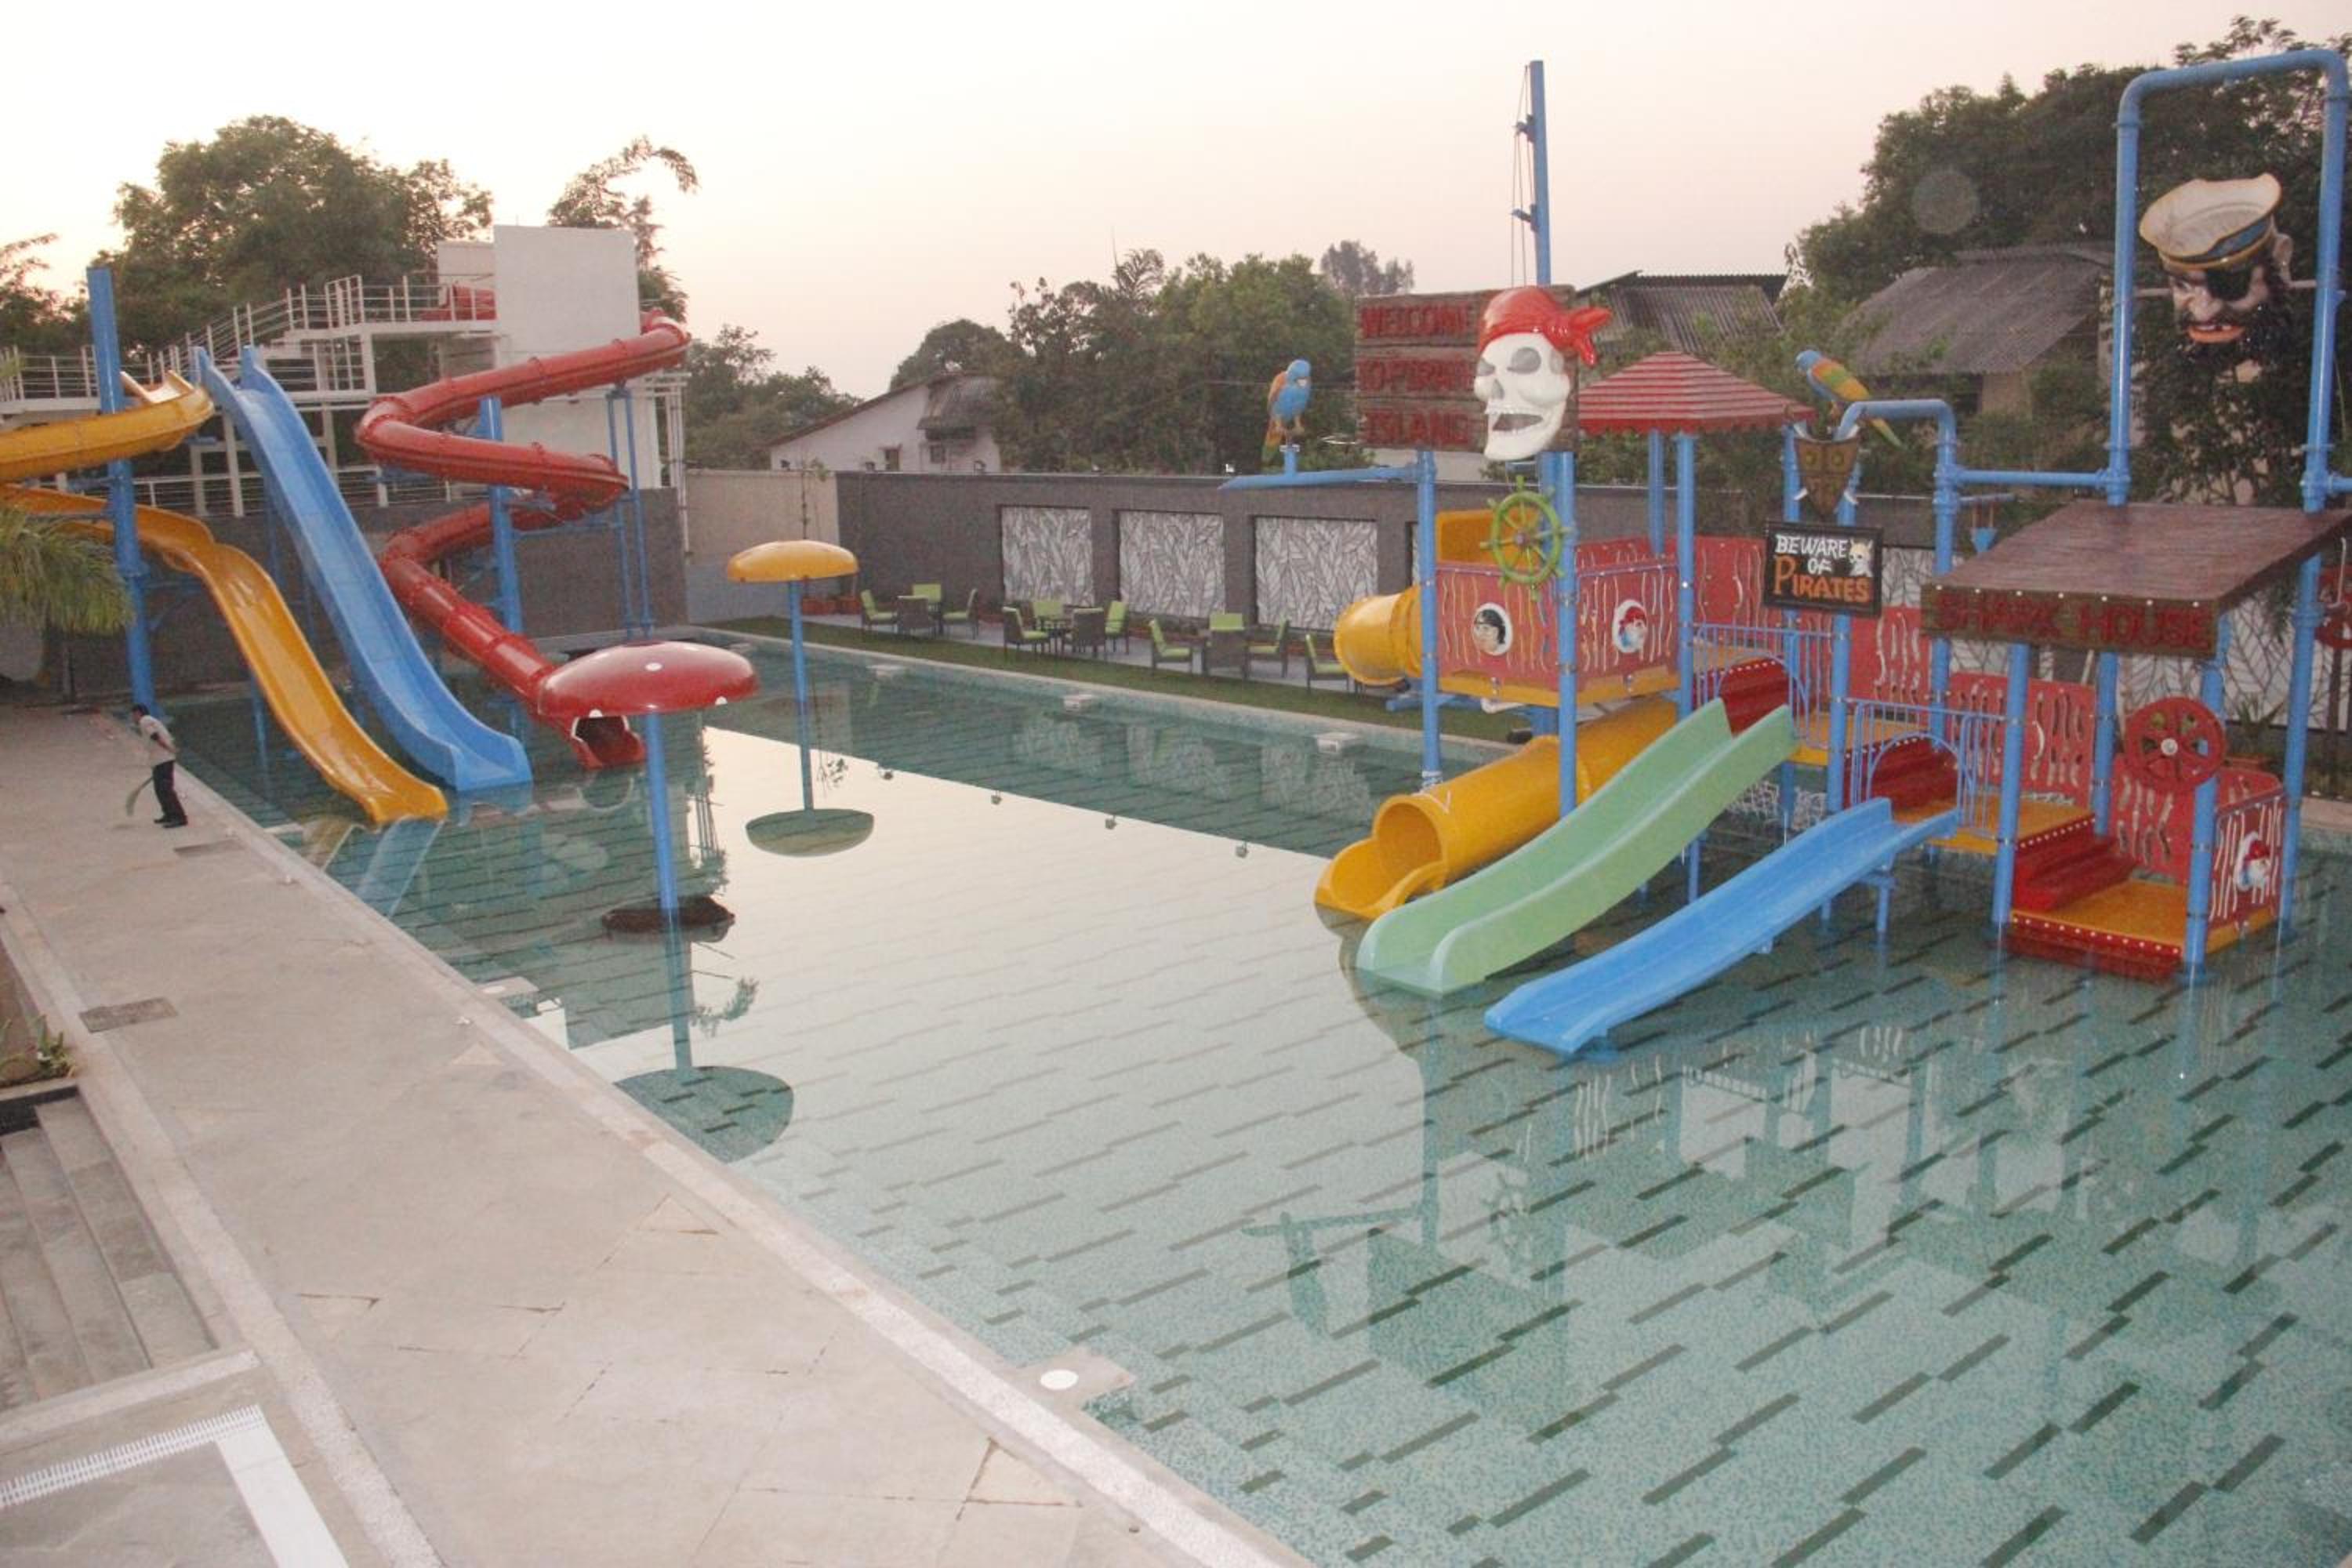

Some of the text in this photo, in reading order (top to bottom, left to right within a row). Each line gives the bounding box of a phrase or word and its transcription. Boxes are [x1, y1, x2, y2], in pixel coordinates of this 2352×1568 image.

[1775, 534, 1848, 559] BEWARE
[1773, 555, 1870, 603] PIRATES
[1807, 557, 1832, 575] OF
[2081, 602, 2209, 650] HOUSE
